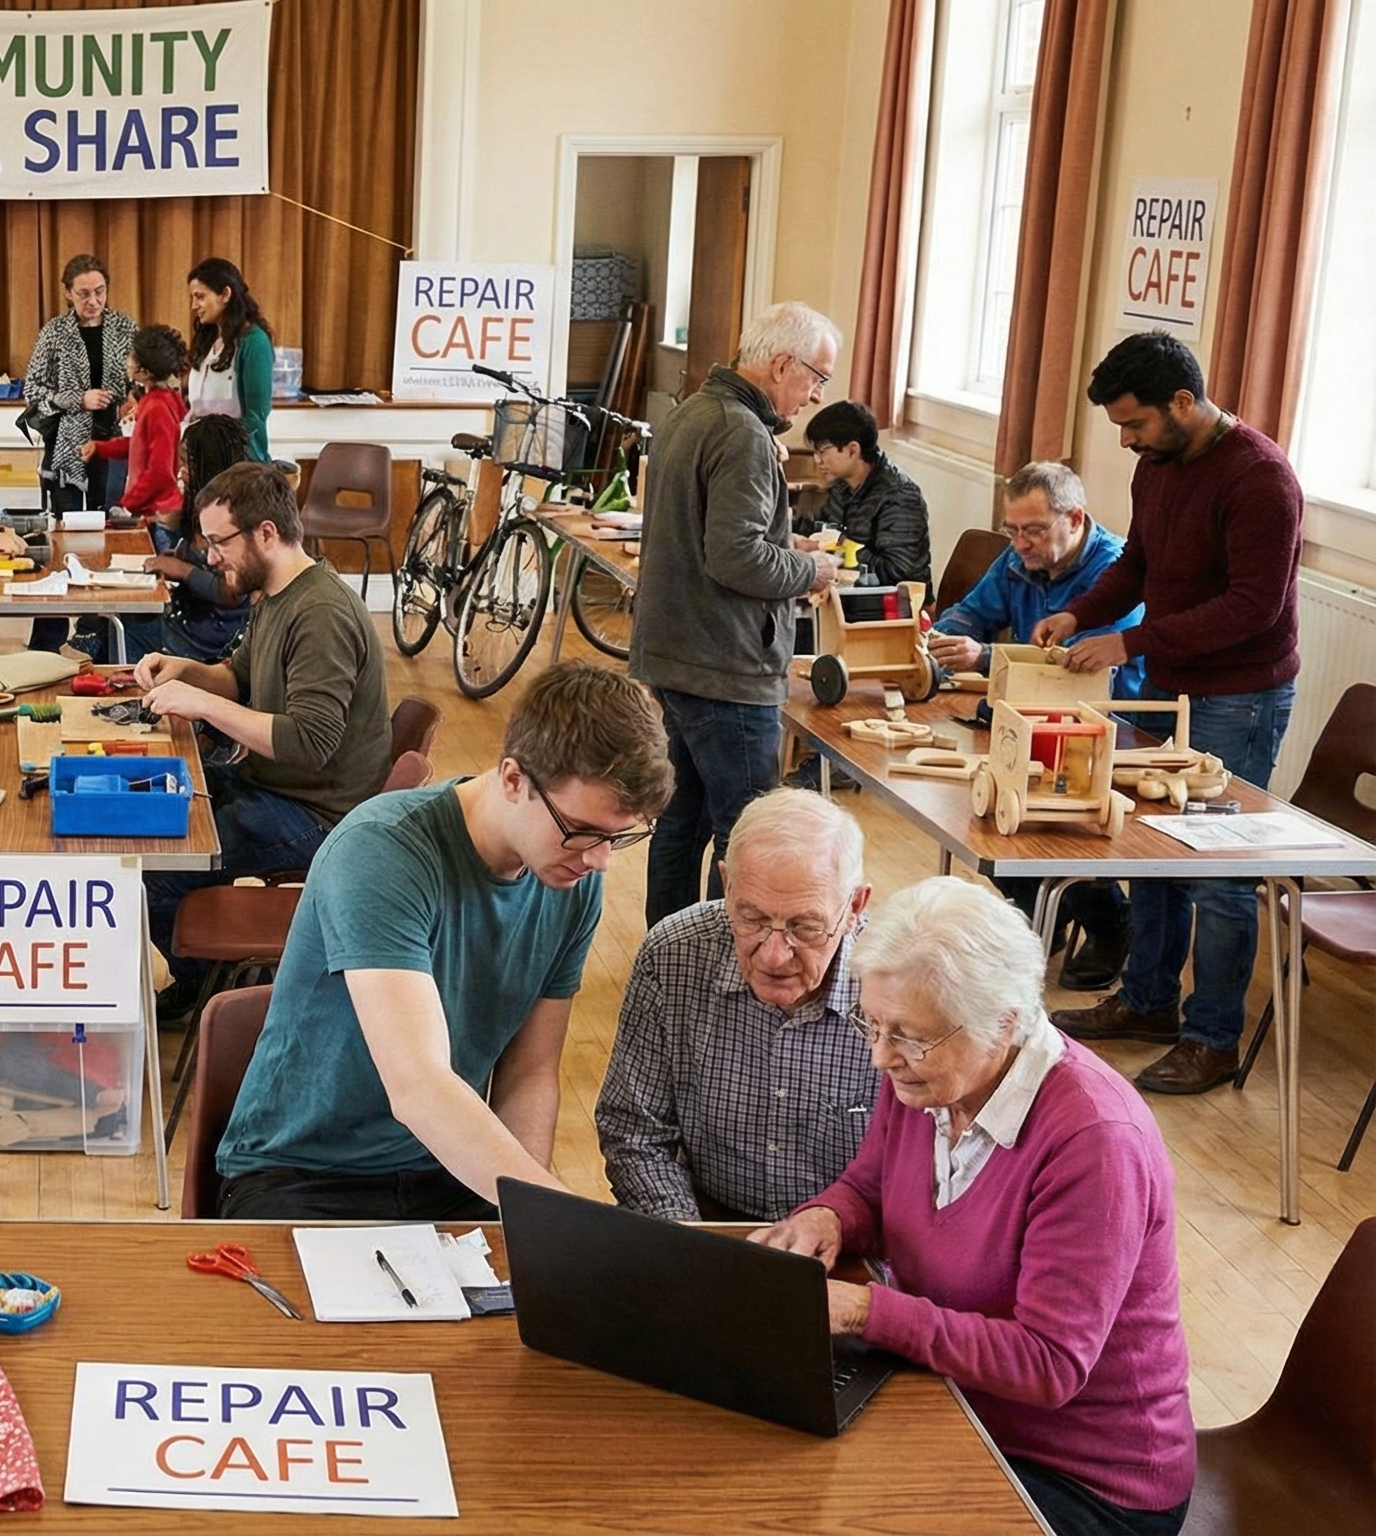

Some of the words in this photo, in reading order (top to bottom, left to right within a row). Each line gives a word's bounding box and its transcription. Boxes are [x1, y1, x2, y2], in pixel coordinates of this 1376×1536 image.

[24, 104, 240, 173] SHARE
[1133, 198, 1206, 242] REPAIR
[414, 276, 535, 311] REPAIR
[1128, 246, 1201, 309] CAFE
[411, 314, 535, 362] CAFE
[114, 1379, 407, 1430] REPAIR
[155, 1434, 369, 1484] CAFE
